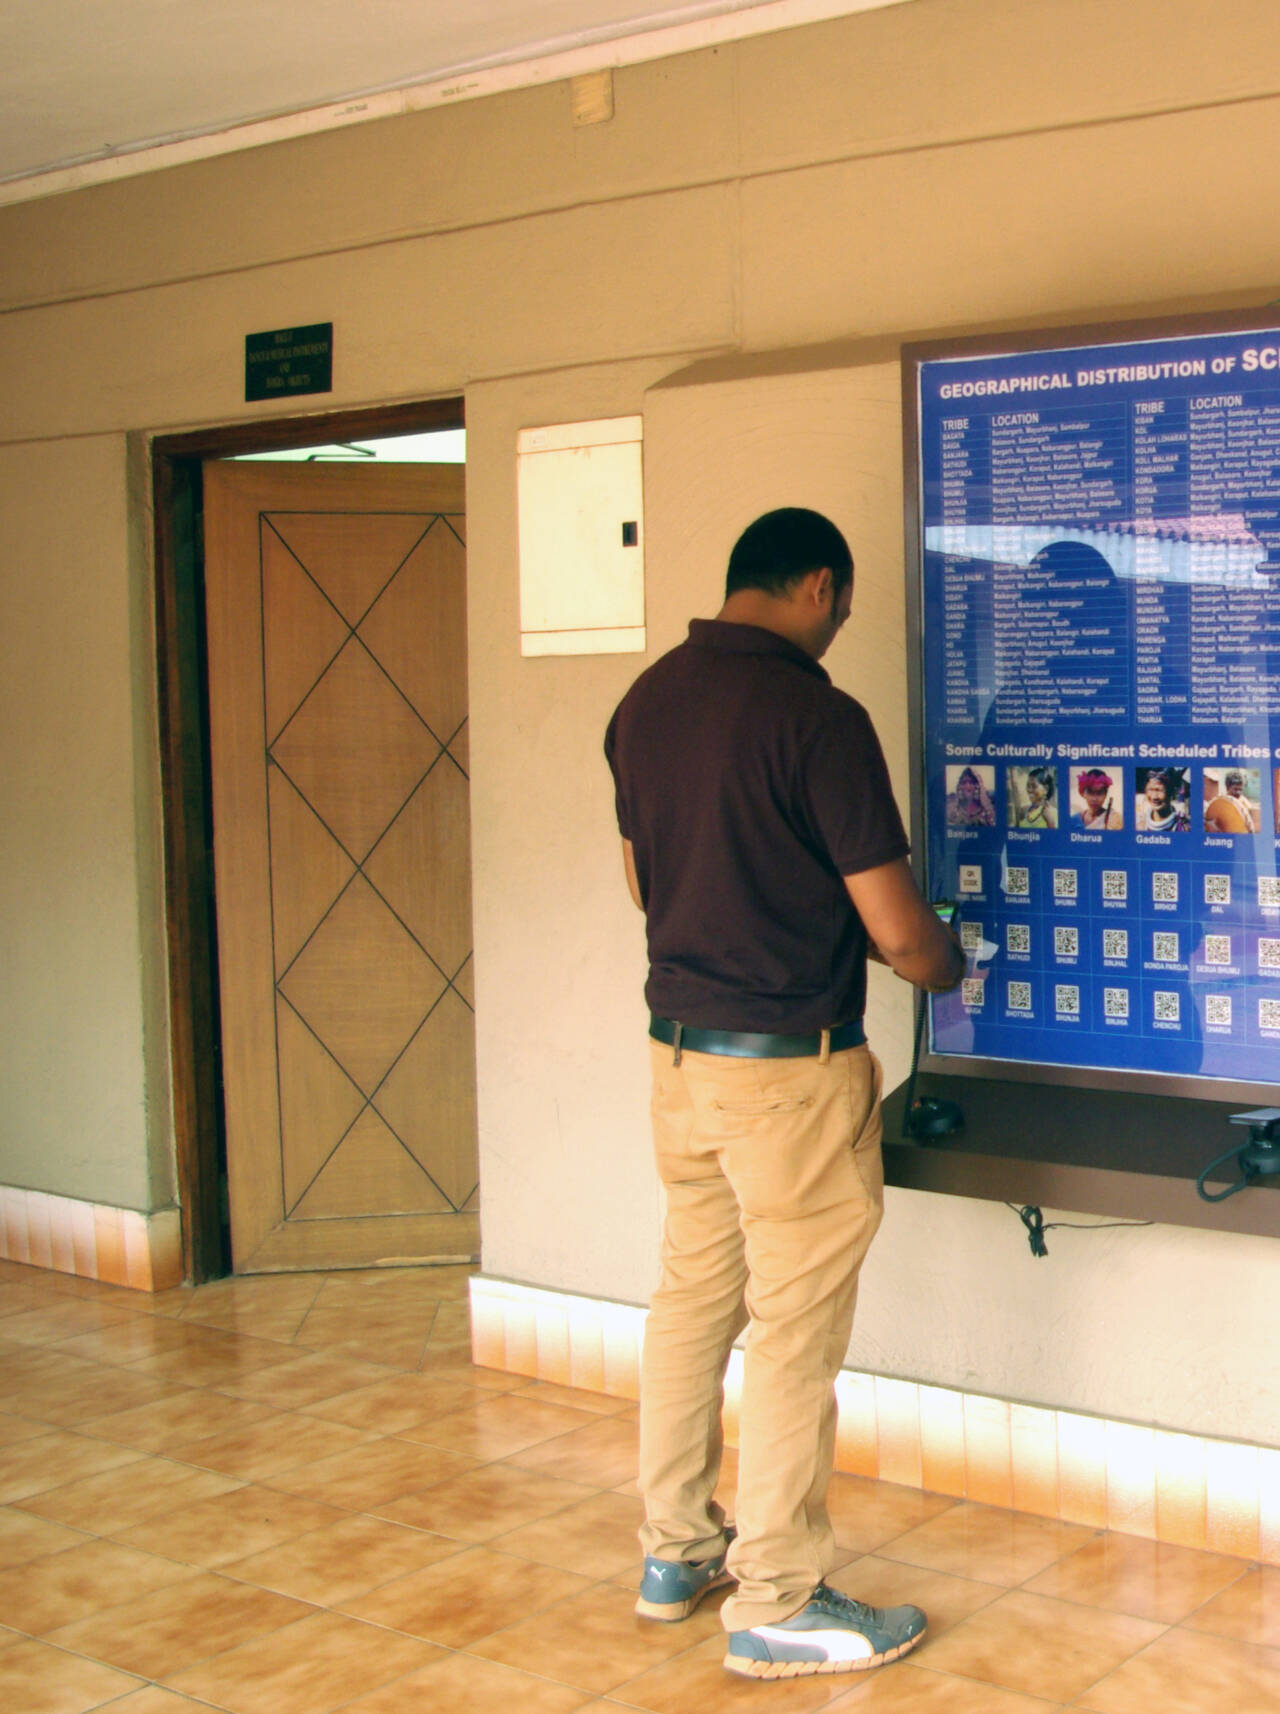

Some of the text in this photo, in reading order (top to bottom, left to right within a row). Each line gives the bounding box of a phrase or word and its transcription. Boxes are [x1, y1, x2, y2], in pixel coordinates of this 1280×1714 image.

[939, 373, 1072, 400] GEOGRAPHICAL
[1077, 359, 1206, 388] DISTRIBUTION
[1211, 357, 1236, 374] OF
[1135, 395, 1242, 414] TRIBE LOCATION
[943, 412, 1039, 430] TRIBE LOCATION
[945, 743, 983, 757] Some
[986, 743, 1053, 760] Culturally
[1057, 744, 1135, 760] Significant
[1138, 744, 1218, 759] Scheduled
[1221, 745, 1270, 760] Tribes
[1007, 831, 1040, 843] Bhunjia
[1070, 833, 1102, 843] Dharua
[1136, 834, 1171, 845] Gadaba
[1203, 837, 1233, 850] Juang
[1167, 963, 1189, 971] PAROJA
